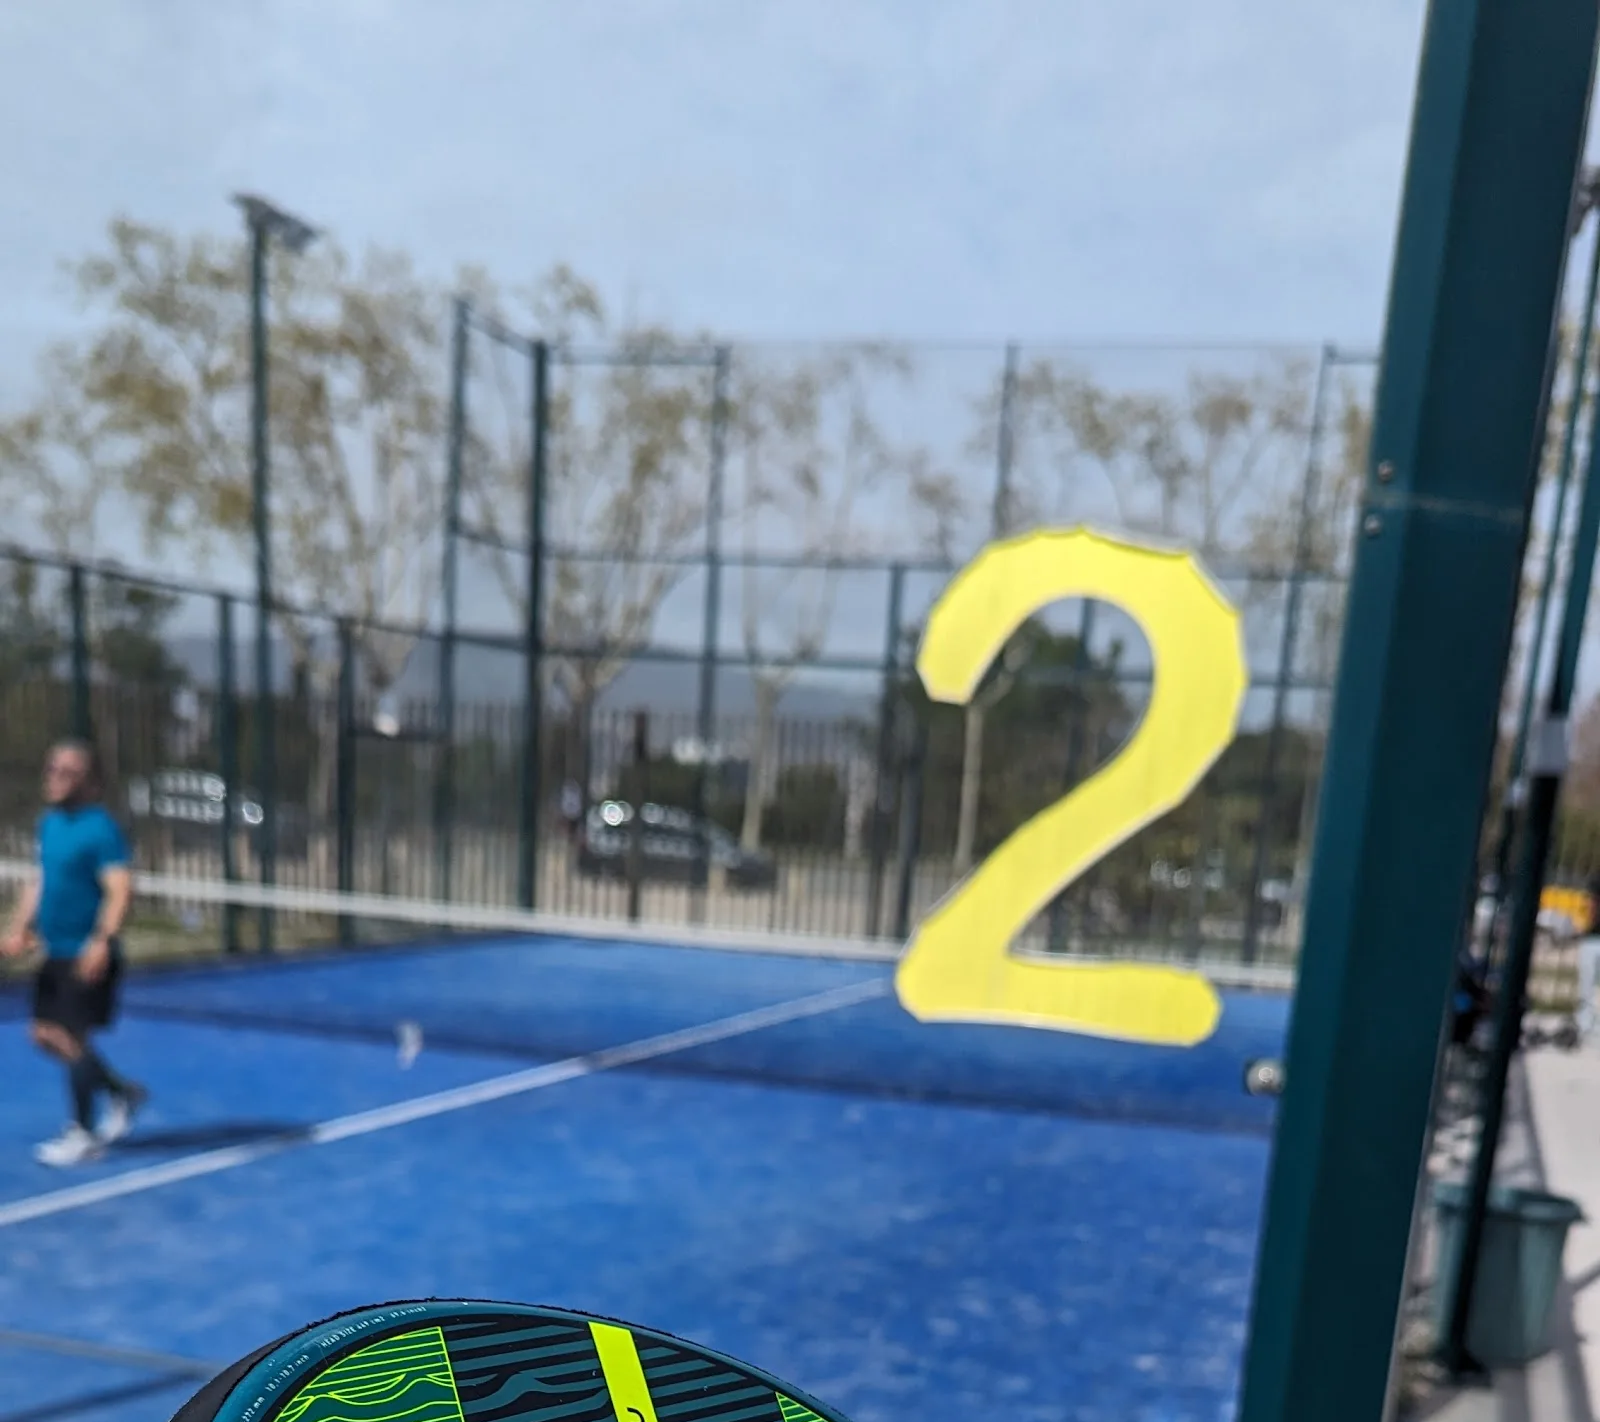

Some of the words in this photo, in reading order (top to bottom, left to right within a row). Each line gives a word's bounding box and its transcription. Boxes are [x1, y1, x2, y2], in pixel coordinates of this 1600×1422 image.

[894, 524, 1249, 1047] 2
[320, 1334, 340, 1348] HEAD
[339, 1326, 357, 1338] SIZE
[253, 1396, 265, 1409] mm
[294, 1354, 310, 1367] inch
